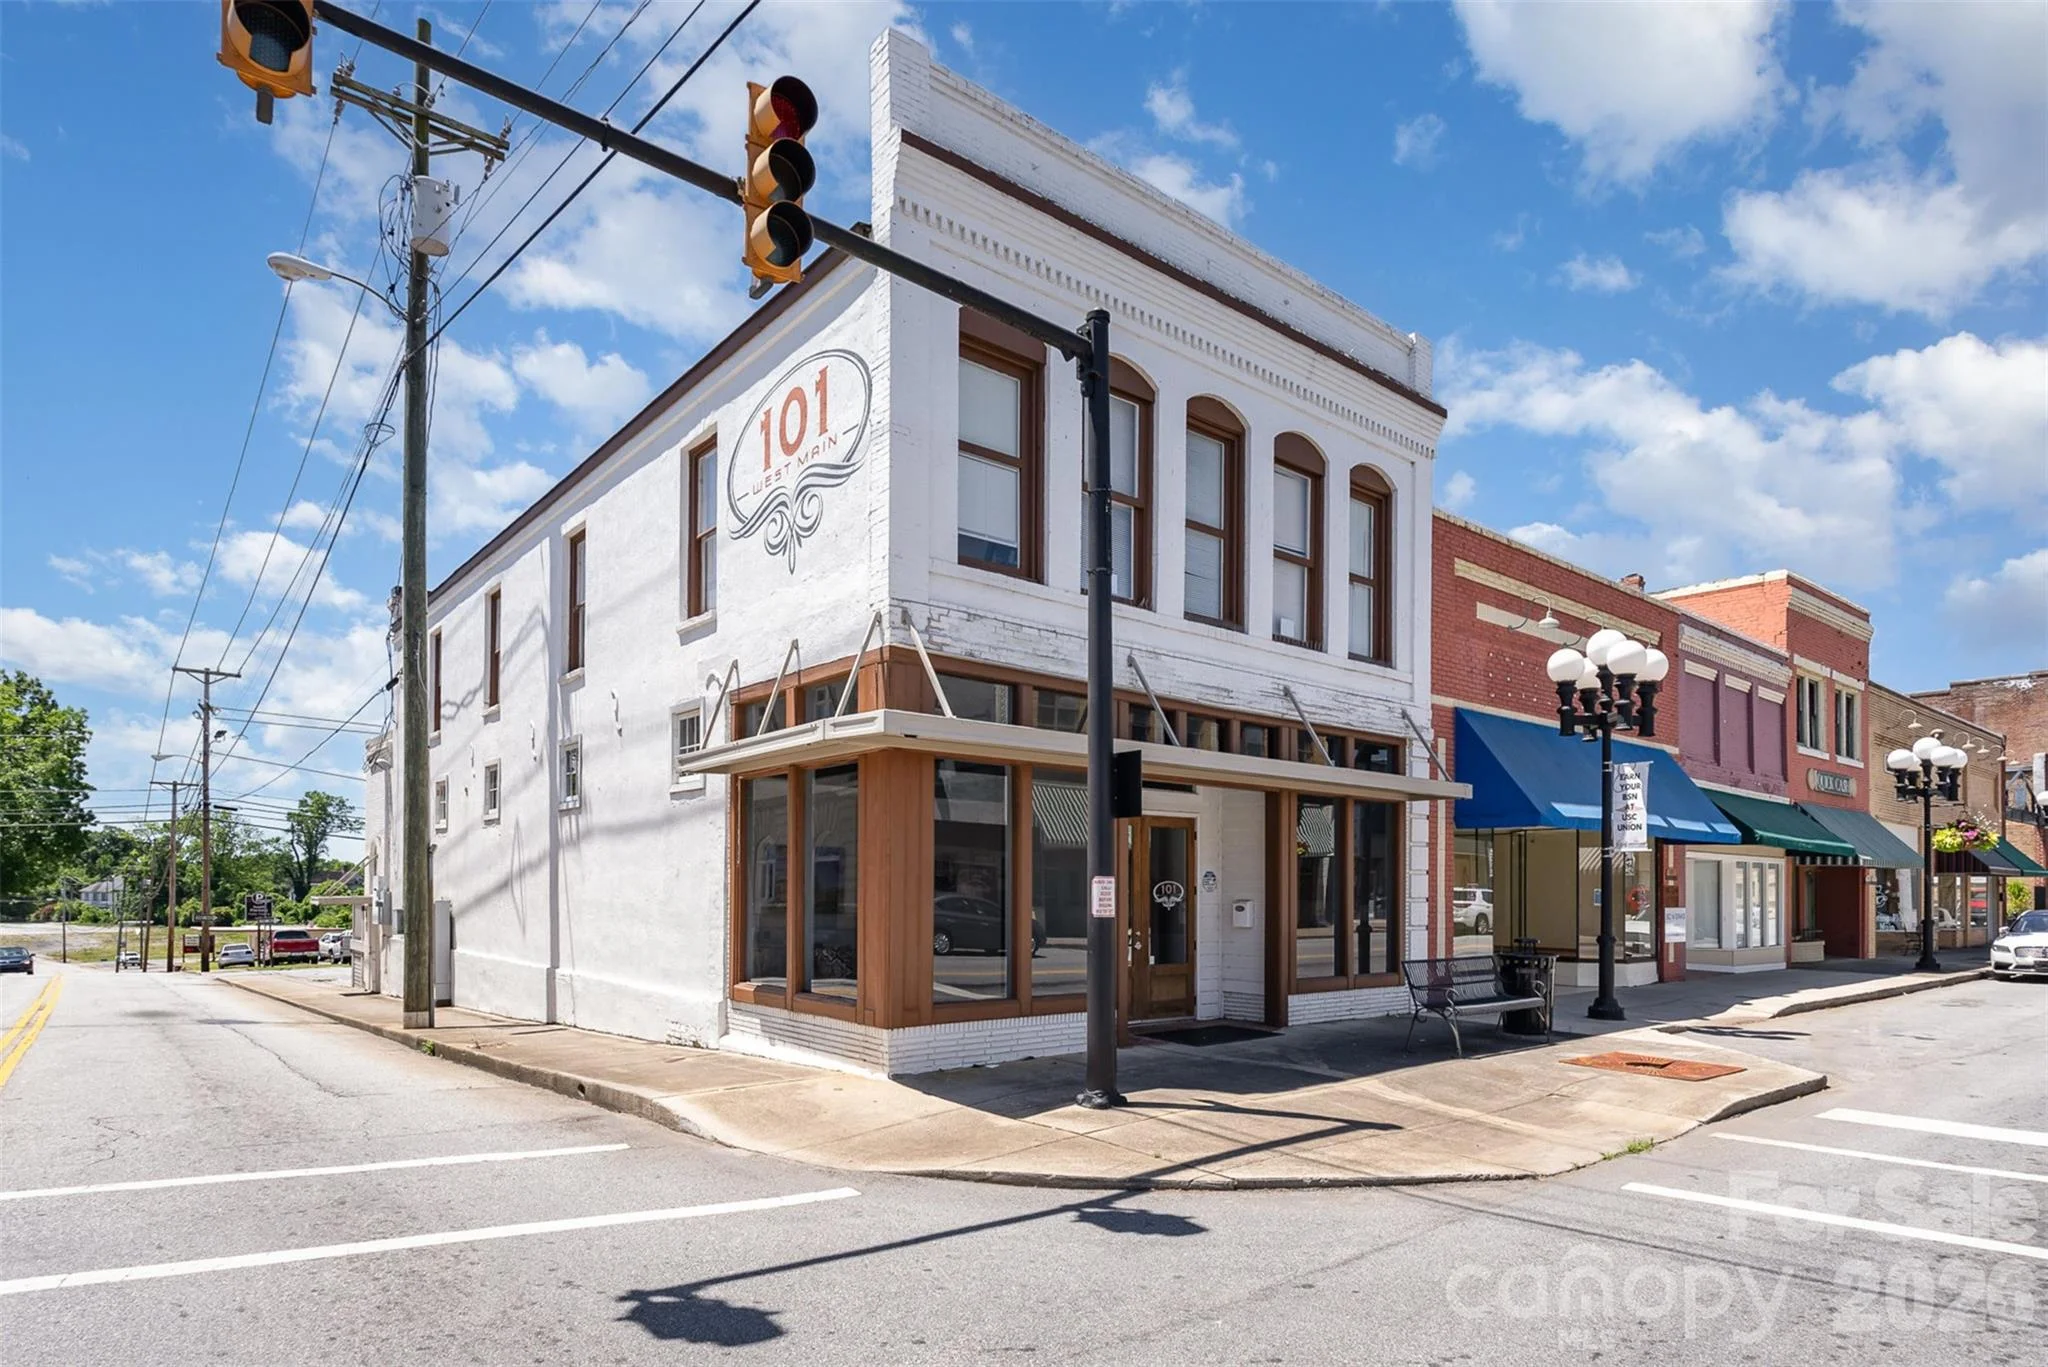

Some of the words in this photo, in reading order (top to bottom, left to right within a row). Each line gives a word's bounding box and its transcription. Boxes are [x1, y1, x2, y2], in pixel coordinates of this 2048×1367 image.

[760, 365, 829, 472] 101
[752, 462, 792, 495] WEST
[797, 435, 838, 467] MAIN
[1161, 884, 1177, 895] 101
